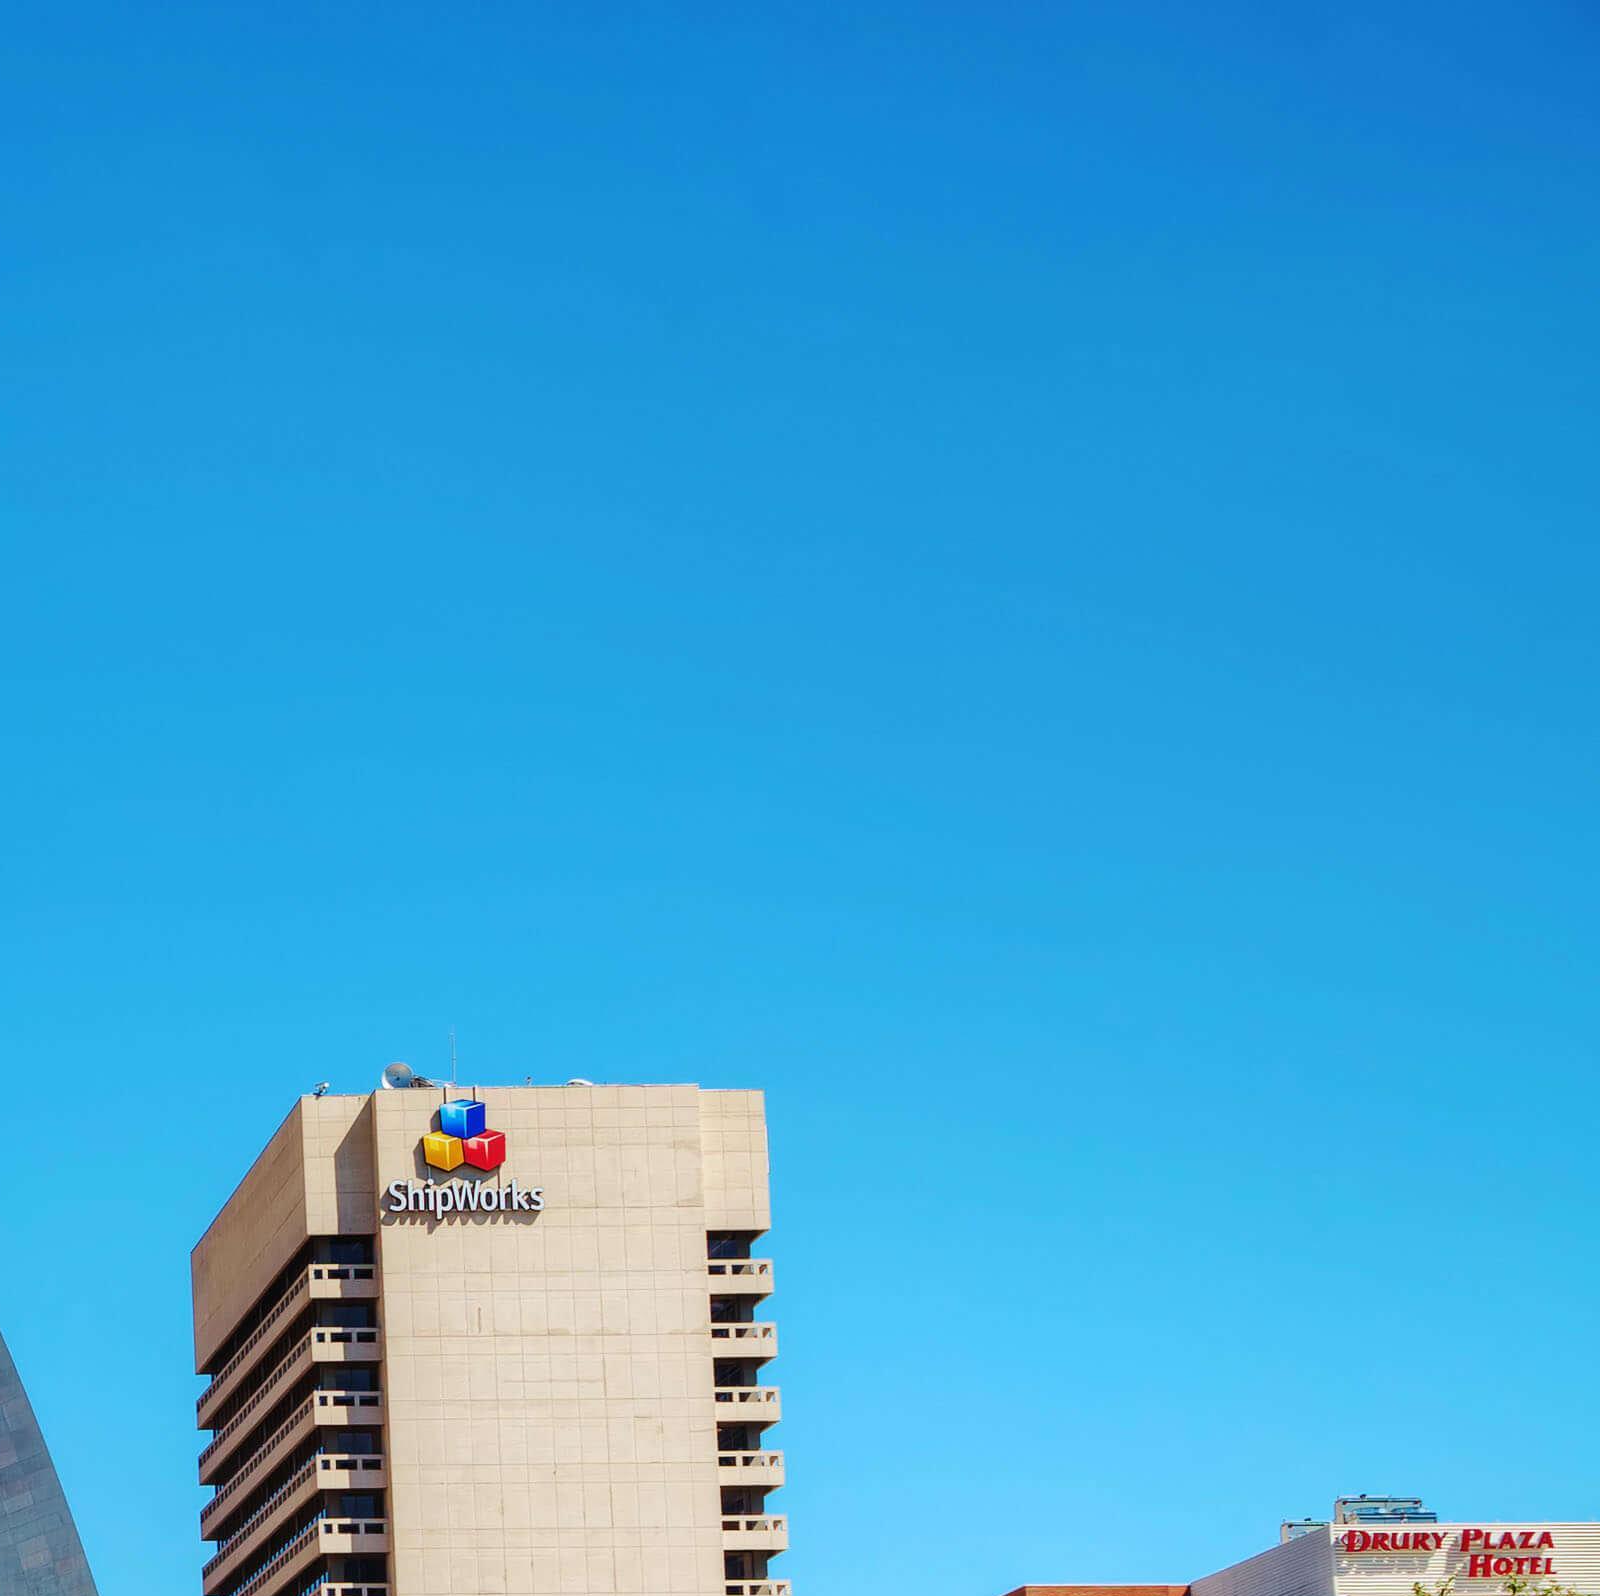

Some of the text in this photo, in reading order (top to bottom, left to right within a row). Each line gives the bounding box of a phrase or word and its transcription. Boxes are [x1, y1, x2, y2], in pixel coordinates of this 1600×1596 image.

[389, 1179, 544, 1219] ShipWorks
[1343, 1528, 1554, 1552] DRURY PLAZA
[1469, 1554, 1557, 1577] HOTEL
